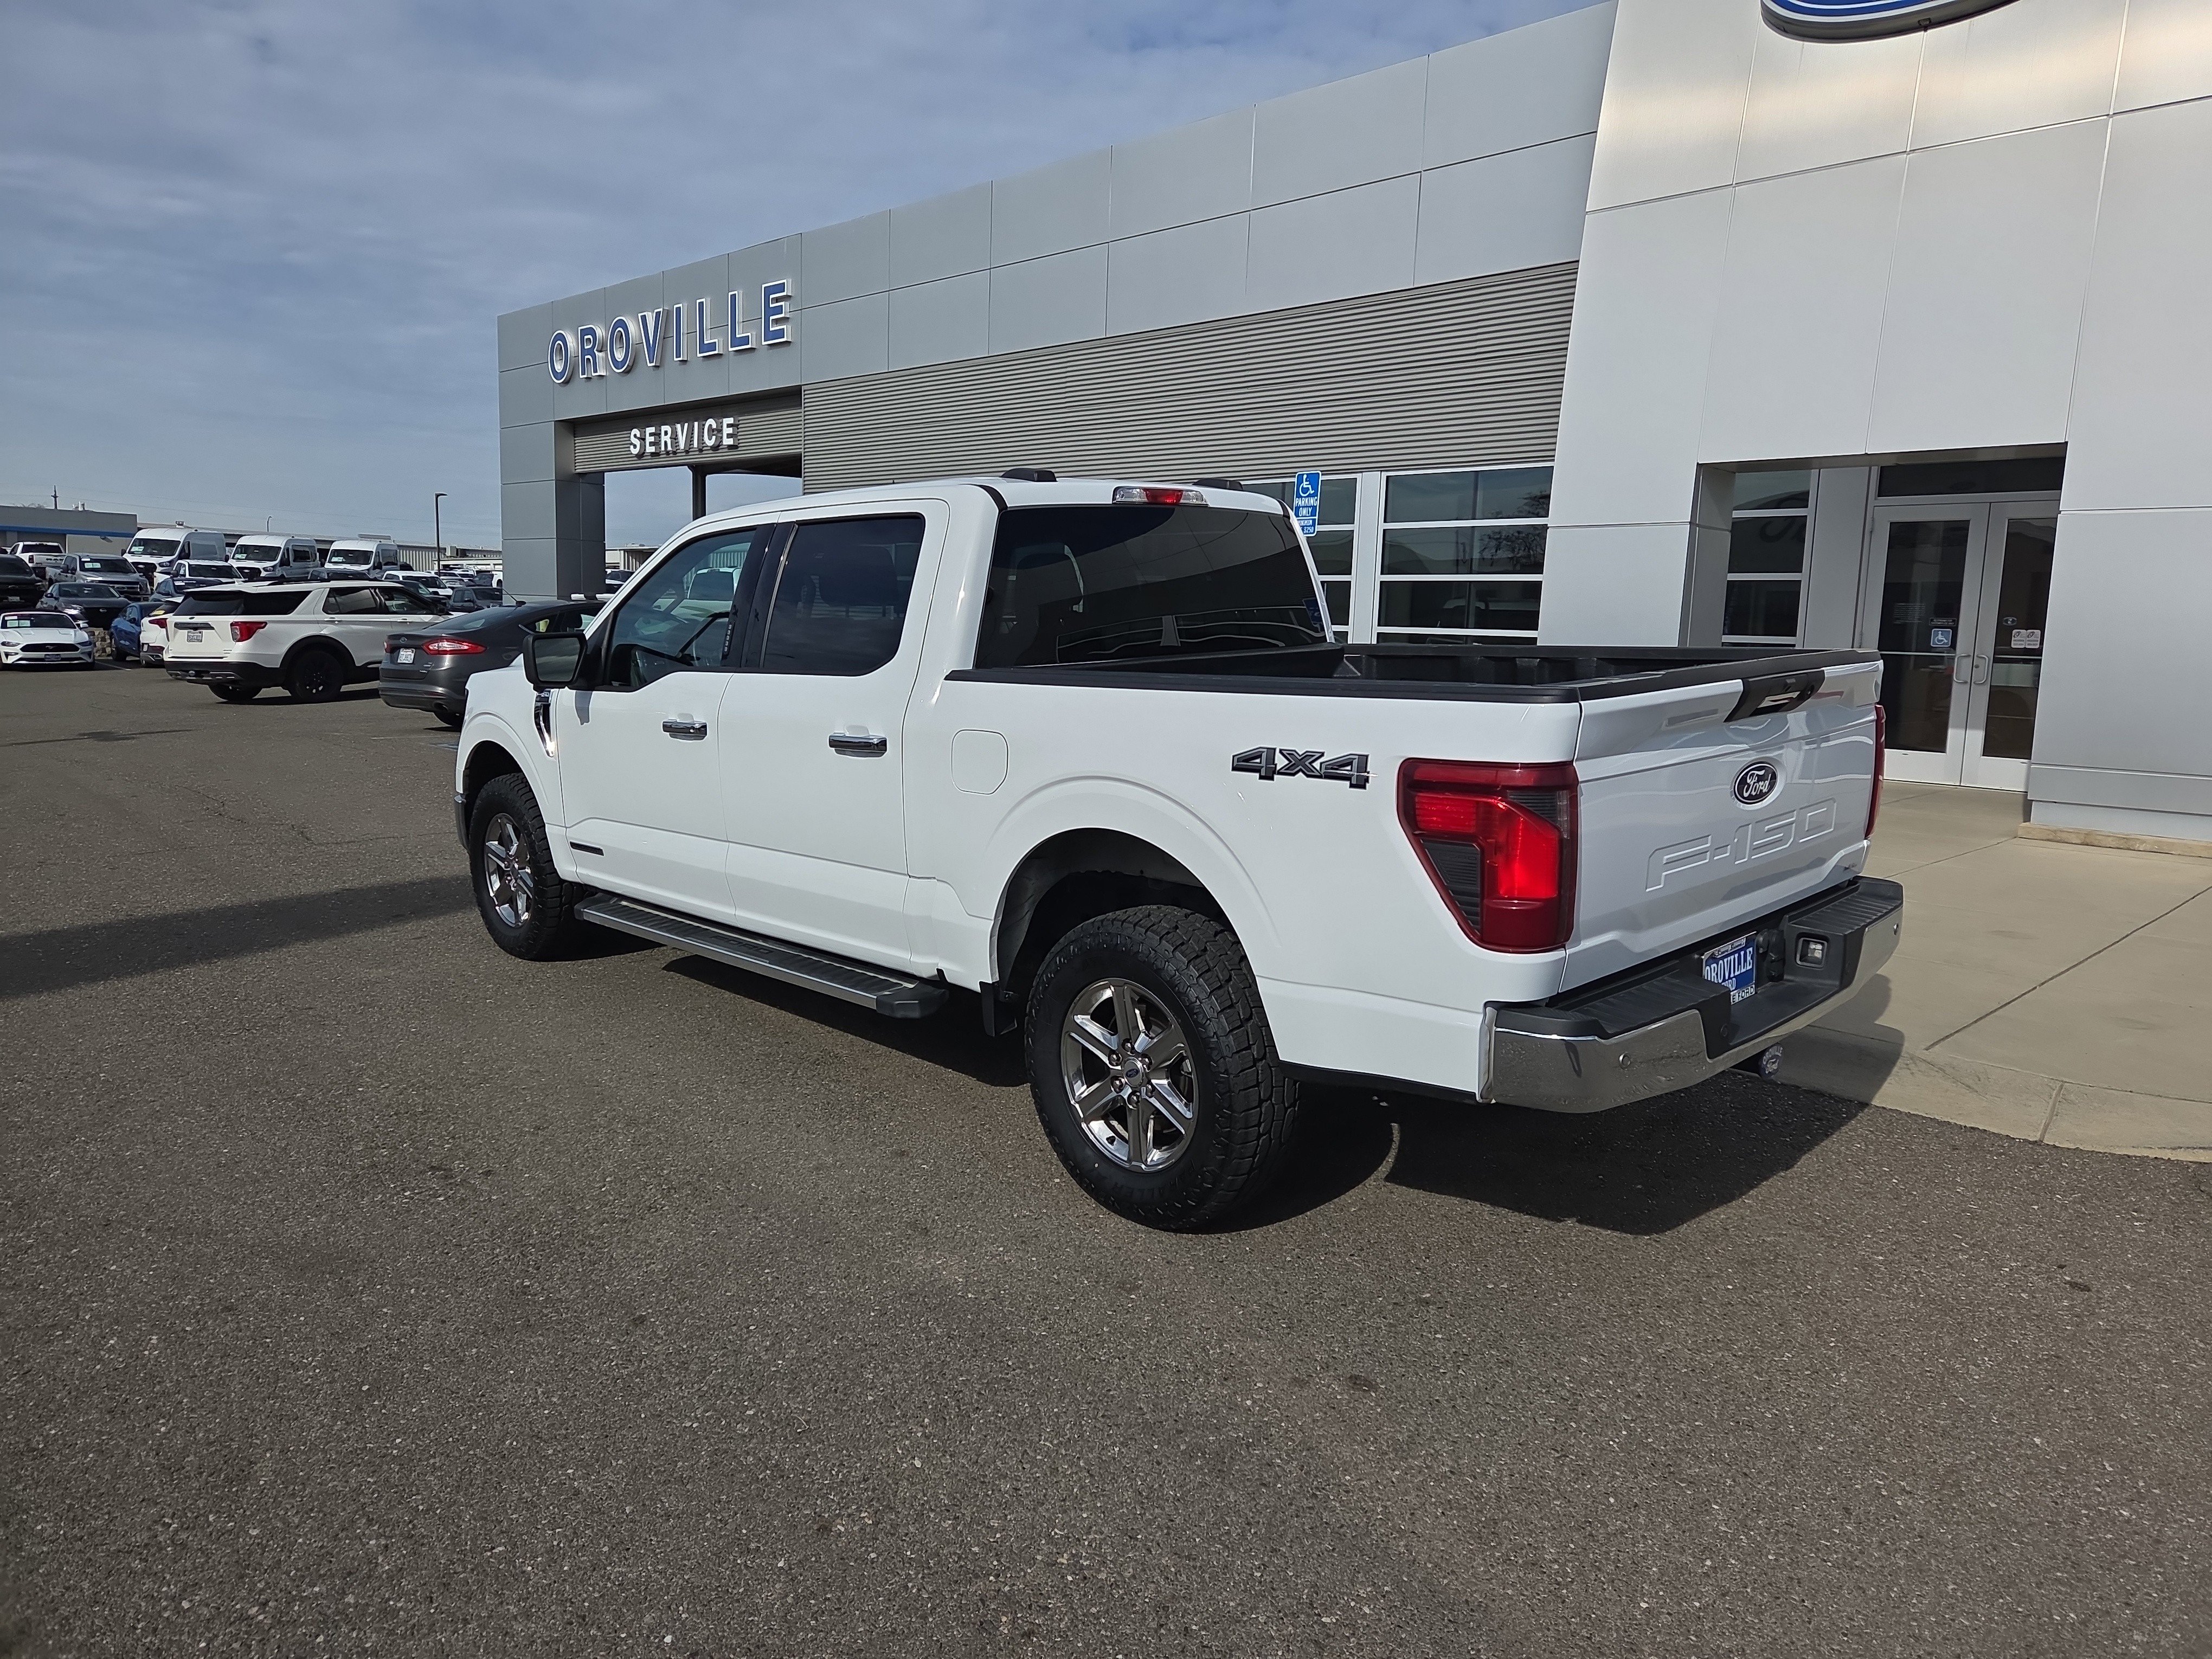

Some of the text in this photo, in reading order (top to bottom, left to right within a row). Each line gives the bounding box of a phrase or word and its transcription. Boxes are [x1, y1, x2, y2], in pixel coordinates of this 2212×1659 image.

[548, 279, 792, 384] OROVILLE
[629, 417, 736, 455] SERVICE
[1295, 497, 1317, 506] PARKING
[1298, 507, 1312, 517] ONLY
[1742, 769, 1771, 798] Ford
[1645, 796, 1837, 892] F-150
[1705, 947, 1753, 983] OROVILLE
[1738, 986, 1754, 1001] FORD
